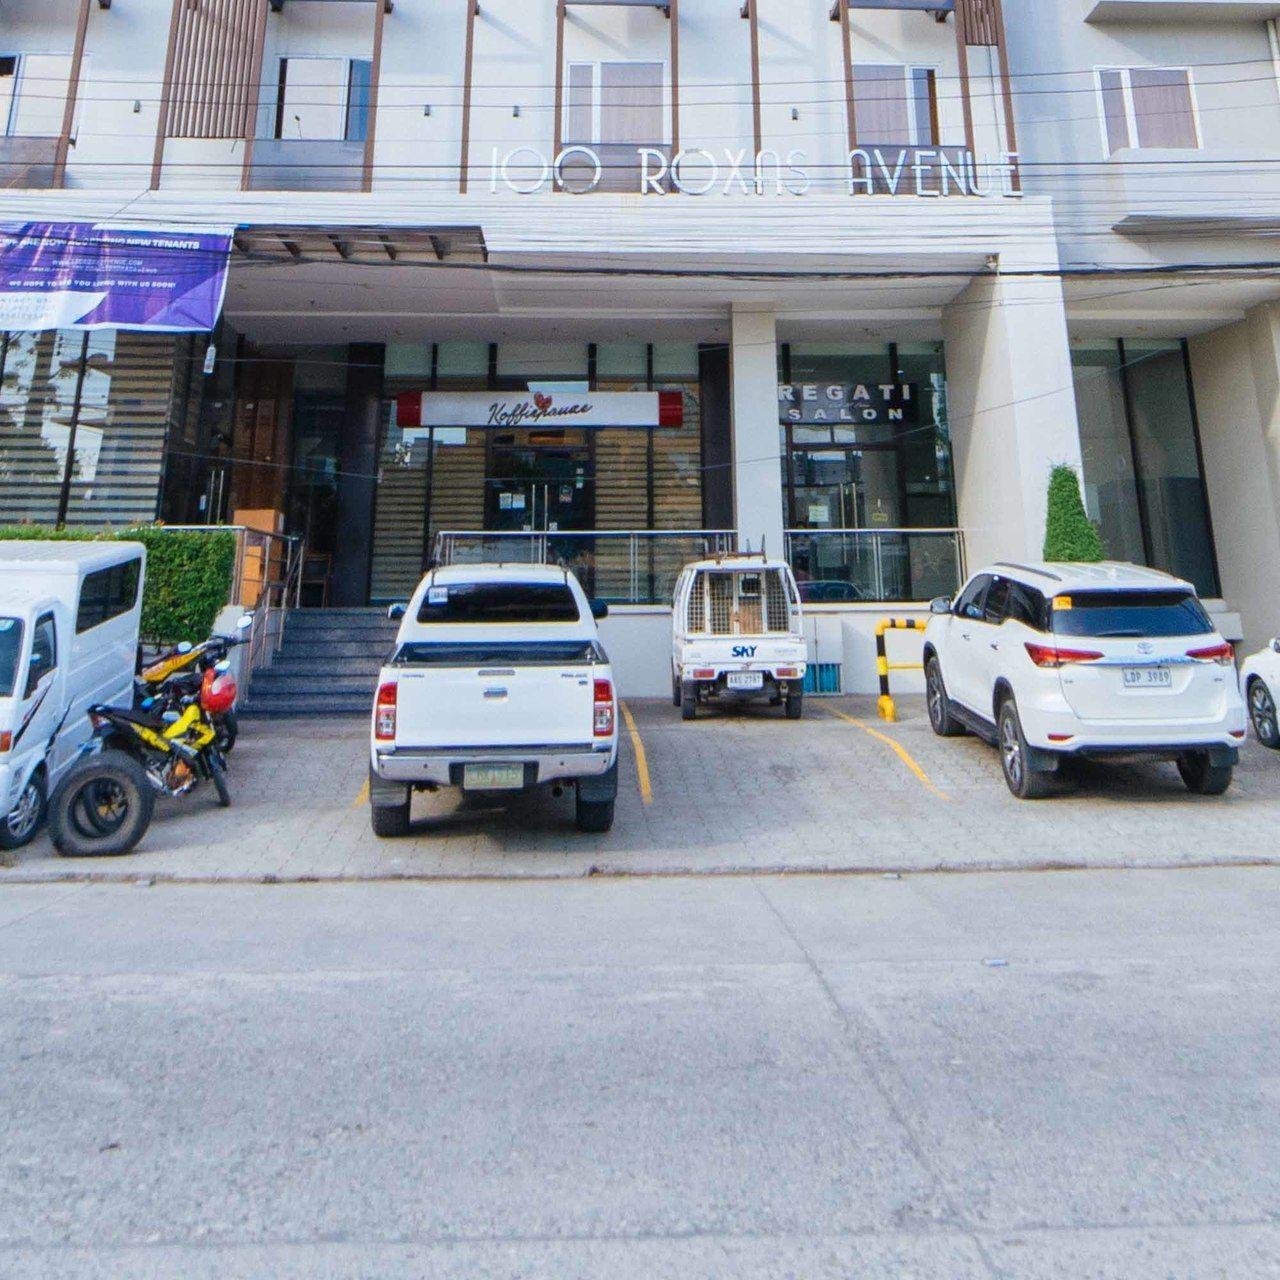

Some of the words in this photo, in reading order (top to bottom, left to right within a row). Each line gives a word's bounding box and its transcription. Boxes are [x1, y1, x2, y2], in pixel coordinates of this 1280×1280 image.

[490, 145, 603, 195] 100
[638, 146, 812, 197] ROXAS
[847, 148, 1025, 199] AVENUE
[126, 238, 151, 247] NEW
[151, 239, 200, 250] TENANTS
[23, 280, 45, 288] HOPE
[74, 279, 91, 288] YOU
[117, 280, 139, 288] WITH
[788, 408, 904, 420] SALON
[731, 645, 758, 658] SKY
